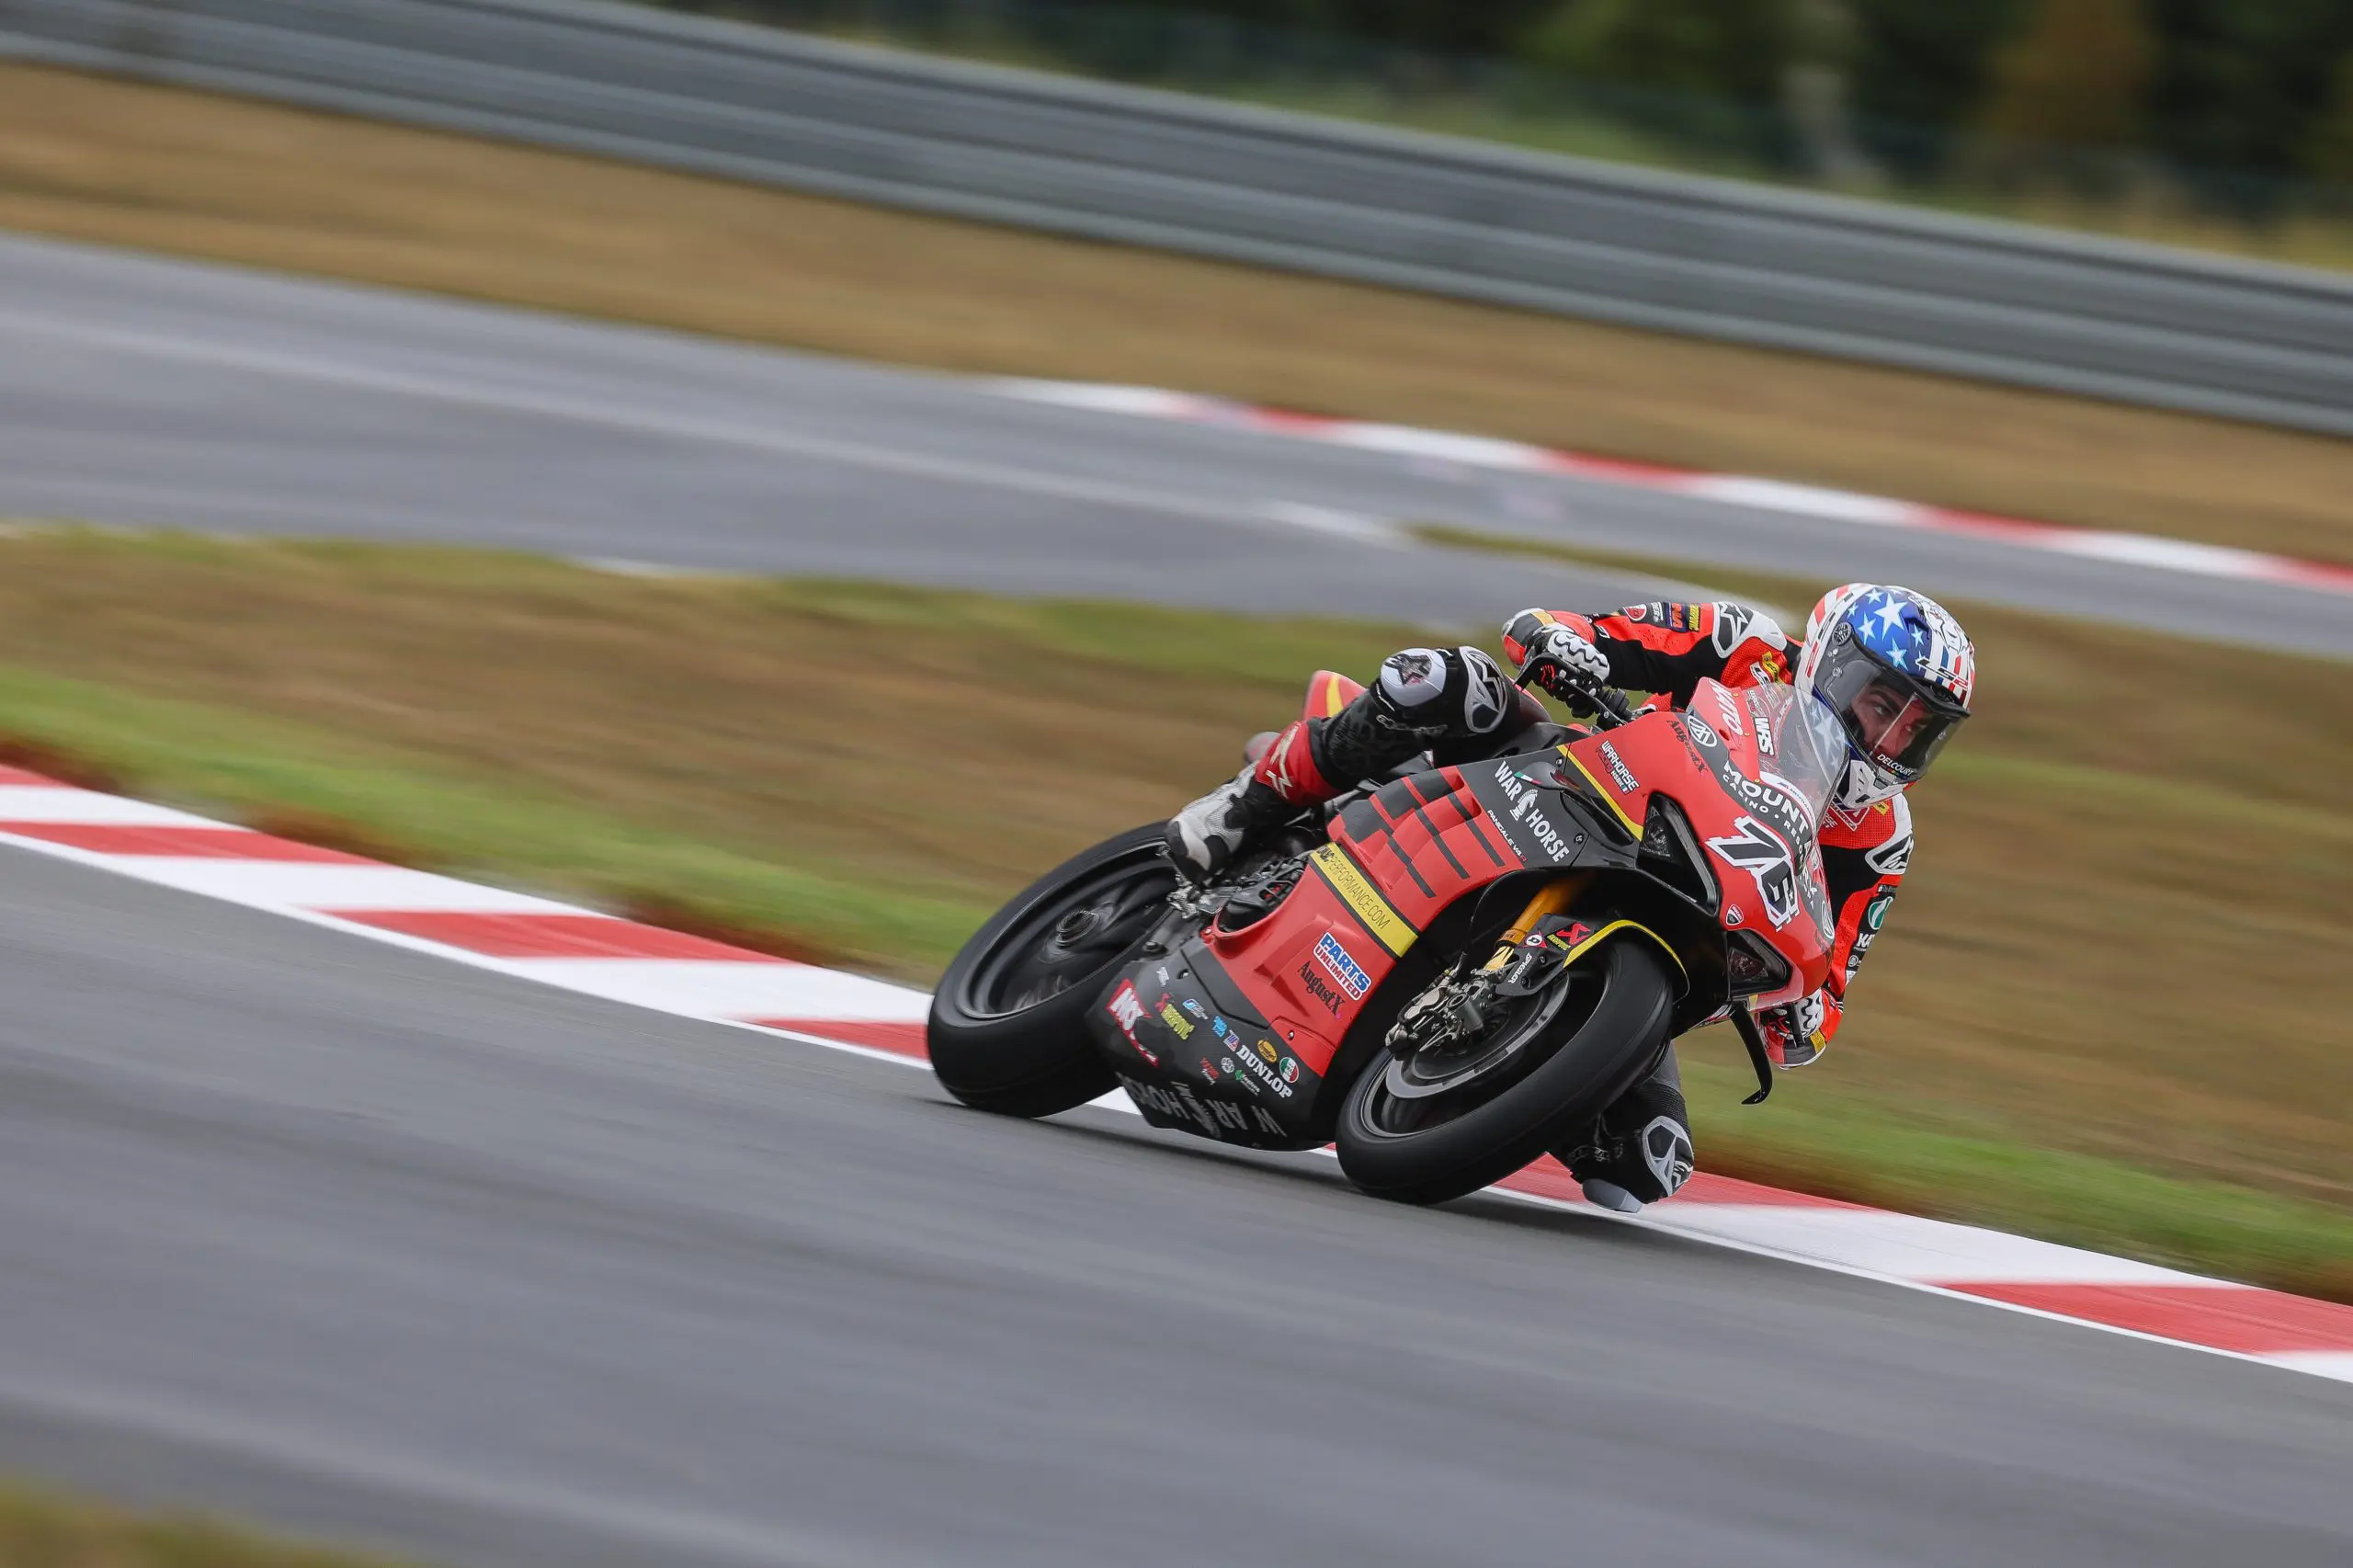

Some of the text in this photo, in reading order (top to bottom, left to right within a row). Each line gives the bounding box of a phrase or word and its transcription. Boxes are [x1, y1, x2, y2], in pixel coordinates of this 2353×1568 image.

[1754, 717, 1775, 756] WRS
[1601, 740, 1640, 791] WARHORSE
[1877, 754, 1914, 778] DELCOURT
[1495, 760, 1570, 862] WAR HORSE
[1722, 774, 1768, 813] CASINO
[1723, 761, 1808, 834] MOUNT
[1487, 810, 1514, 846] PANIGALE
[1705, 815, 1800, 932] 76
[1315, 946, 1361, 1000] UNLIMITED
[1320, 934, 1370, 992] PARTS
[1507, 951, 1532, 984] SPIEGLER
[1236, 1044, 1293, 1098] DUNLOP
